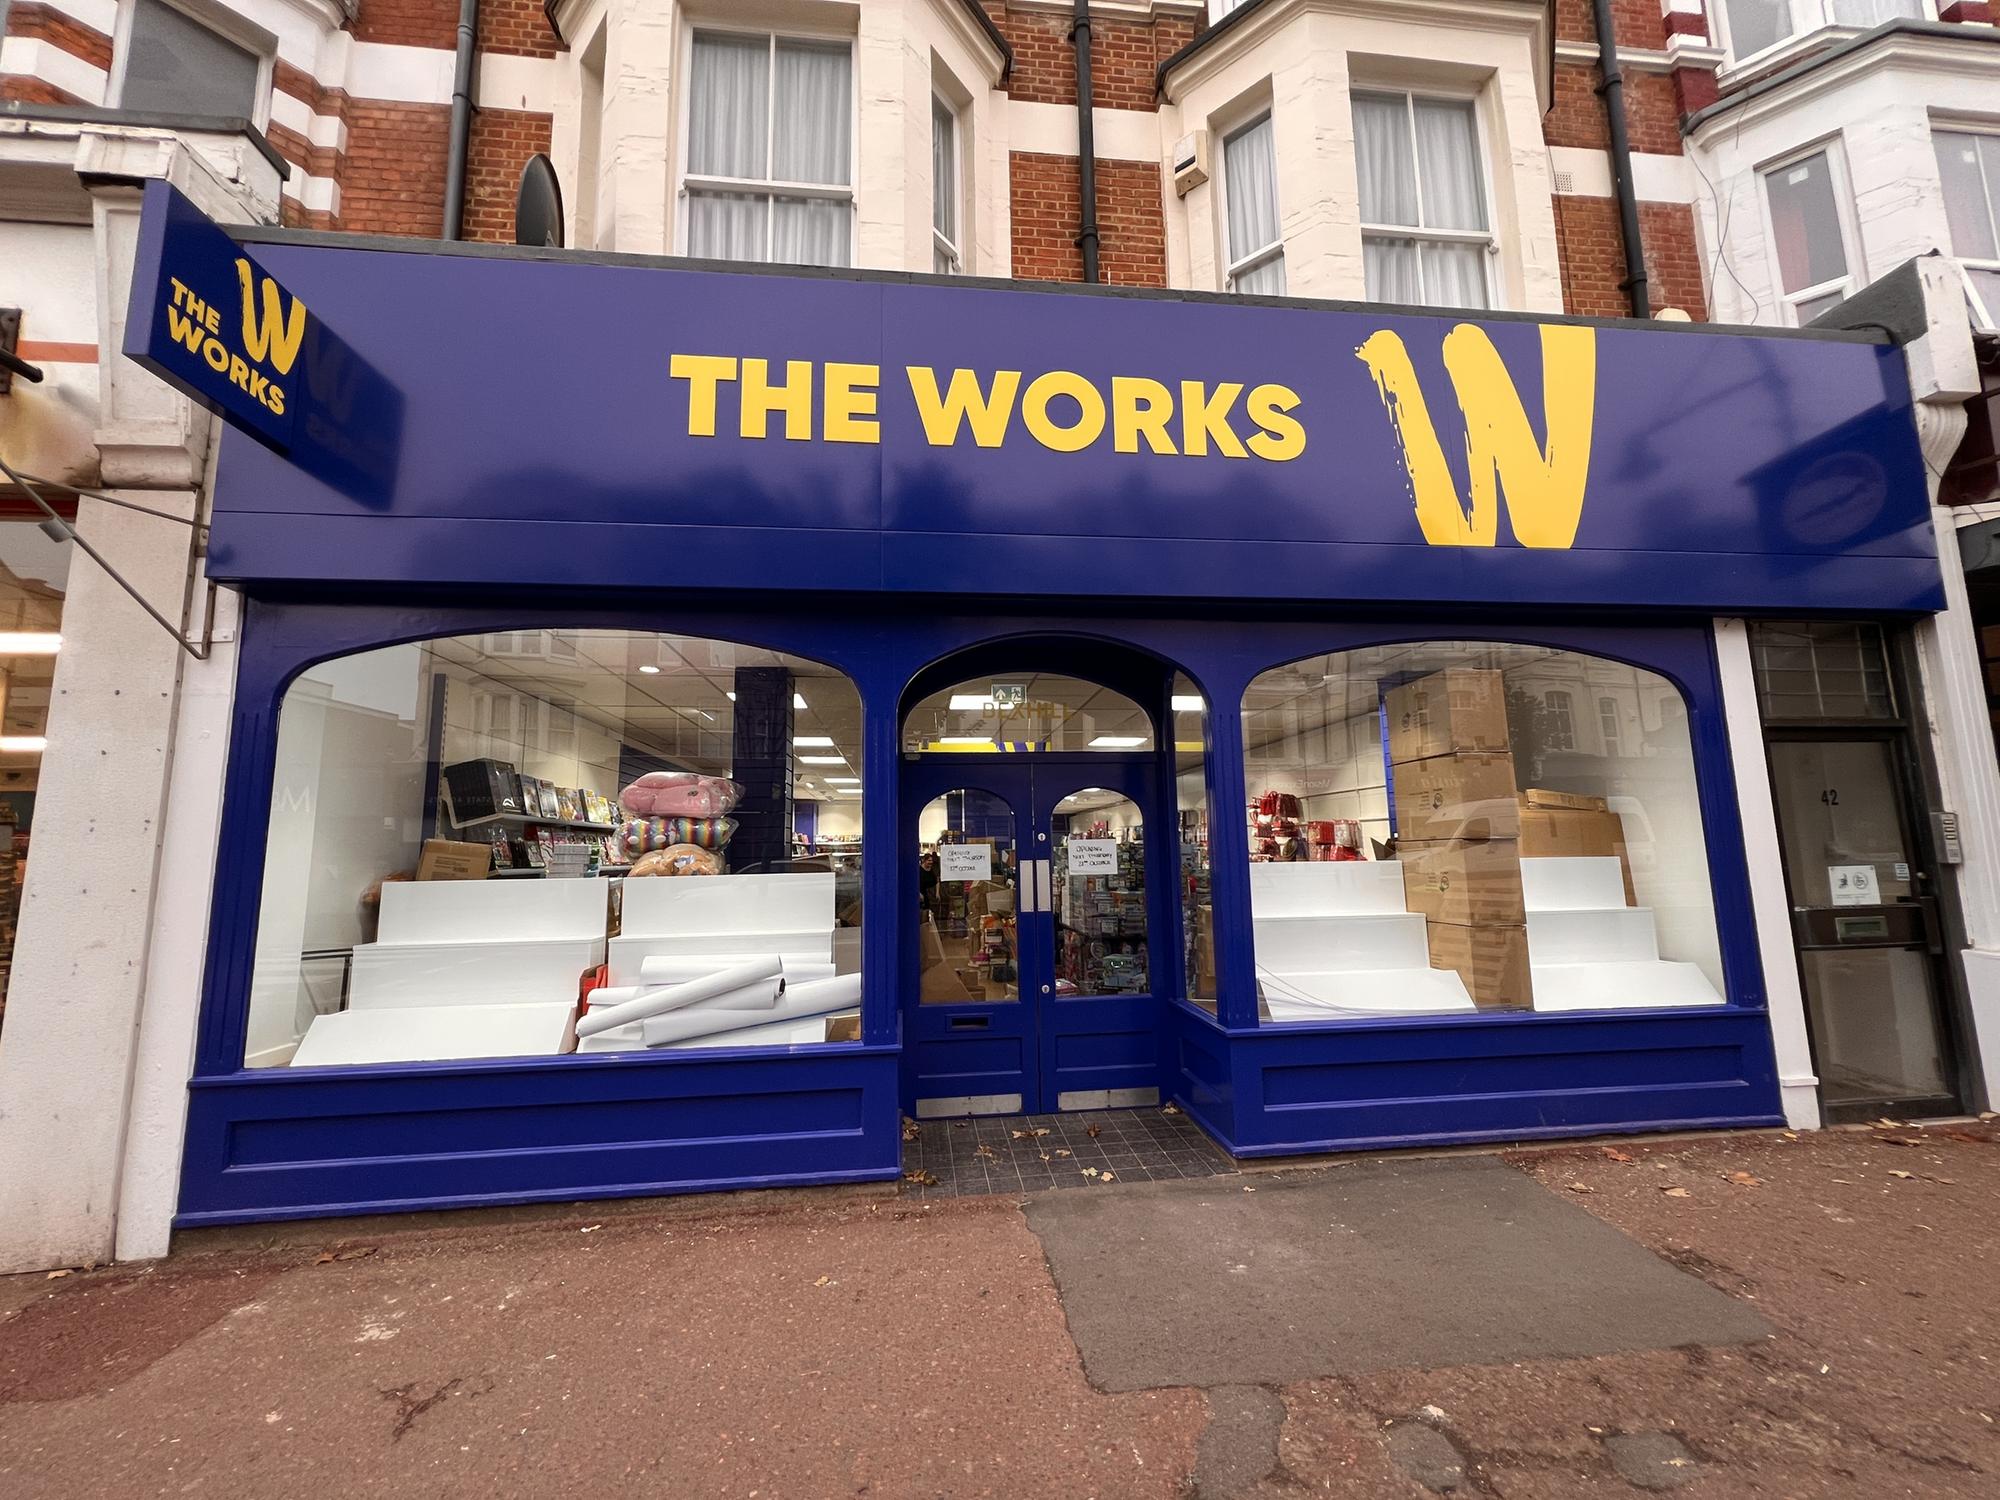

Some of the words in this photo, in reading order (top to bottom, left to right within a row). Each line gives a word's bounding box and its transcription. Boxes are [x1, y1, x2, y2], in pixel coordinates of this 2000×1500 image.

[171, 277, 219, 333] THE
[235, 258, 306, 374] W
[168, 306, 285, 415] WORKS
[670, 355, 881, 444] THE
[906, 367, 1306, 461] WORKS
[1355, 323, 1597, 549] W
[982, 702, 1070, 720] BEXHILL
[1821, 789, 1839, 806] 42
